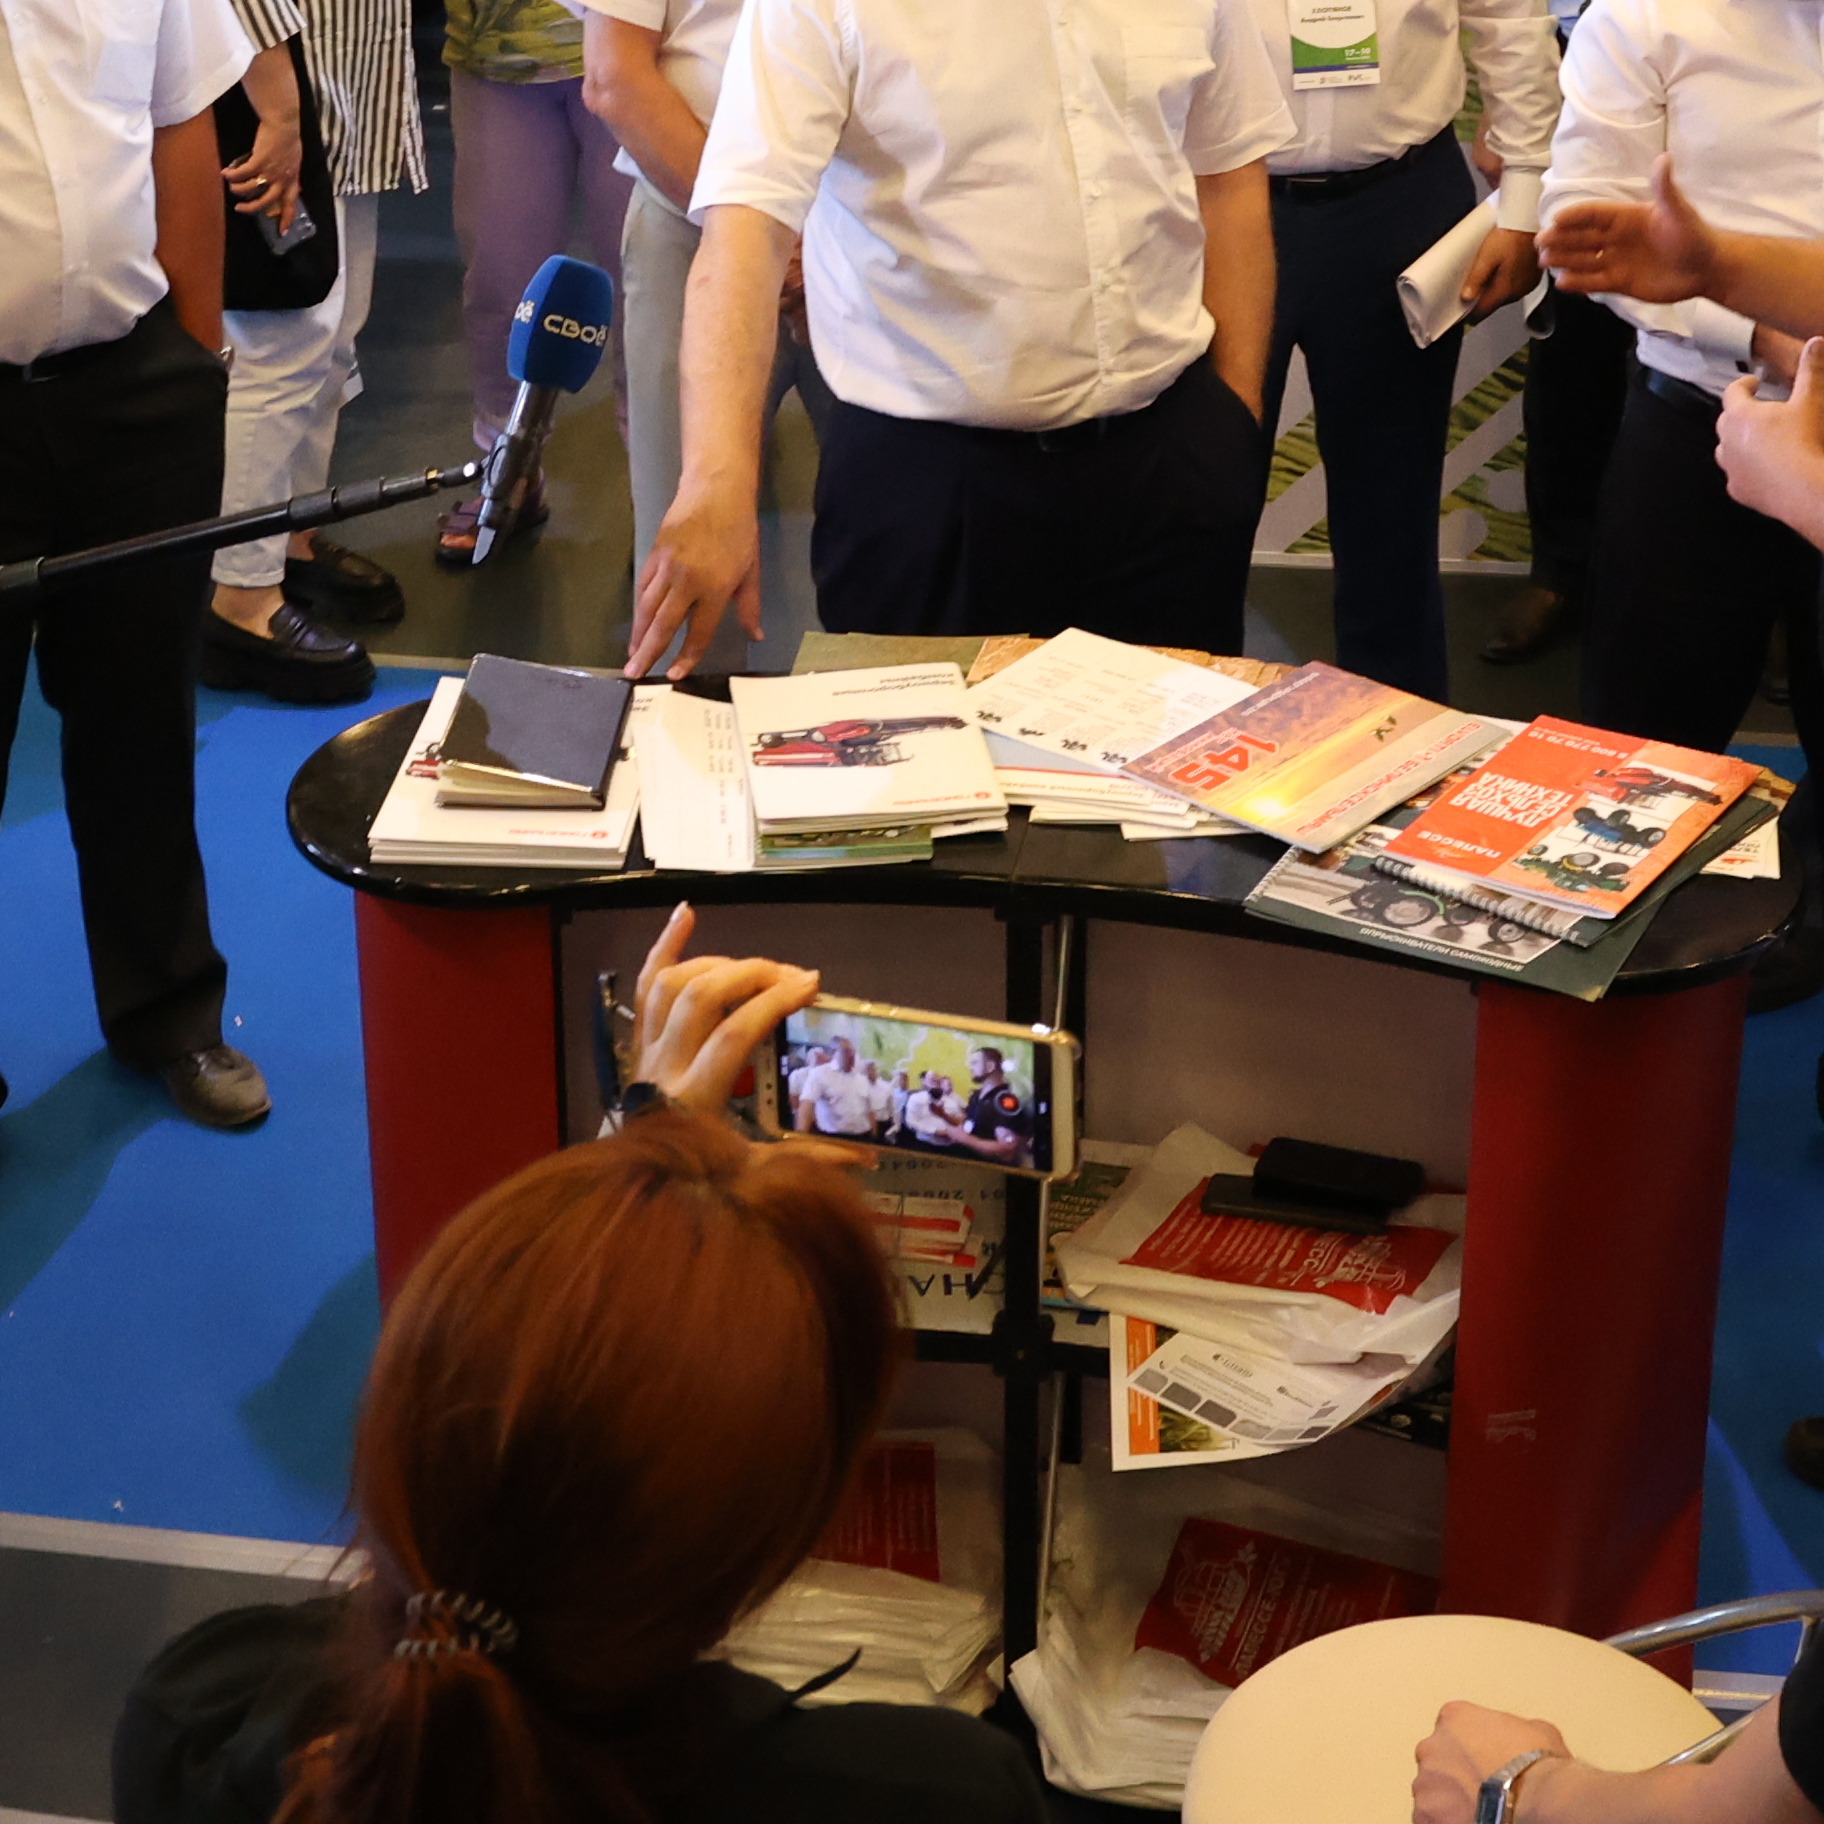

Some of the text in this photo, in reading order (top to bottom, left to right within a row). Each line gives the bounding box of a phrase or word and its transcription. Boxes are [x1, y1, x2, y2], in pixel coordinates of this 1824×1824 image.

[1168, 729, 1279, 792] 145
[1461, 782, 1564, 818] СЕЛЬХОЗ
[1477, 772, 1576, 808] ТЕХНИКА
[1448, 792, 1547, 828] ЛУЧШАЯ
[1417, 829, 1503, 860] ПАЛЕССЕ
